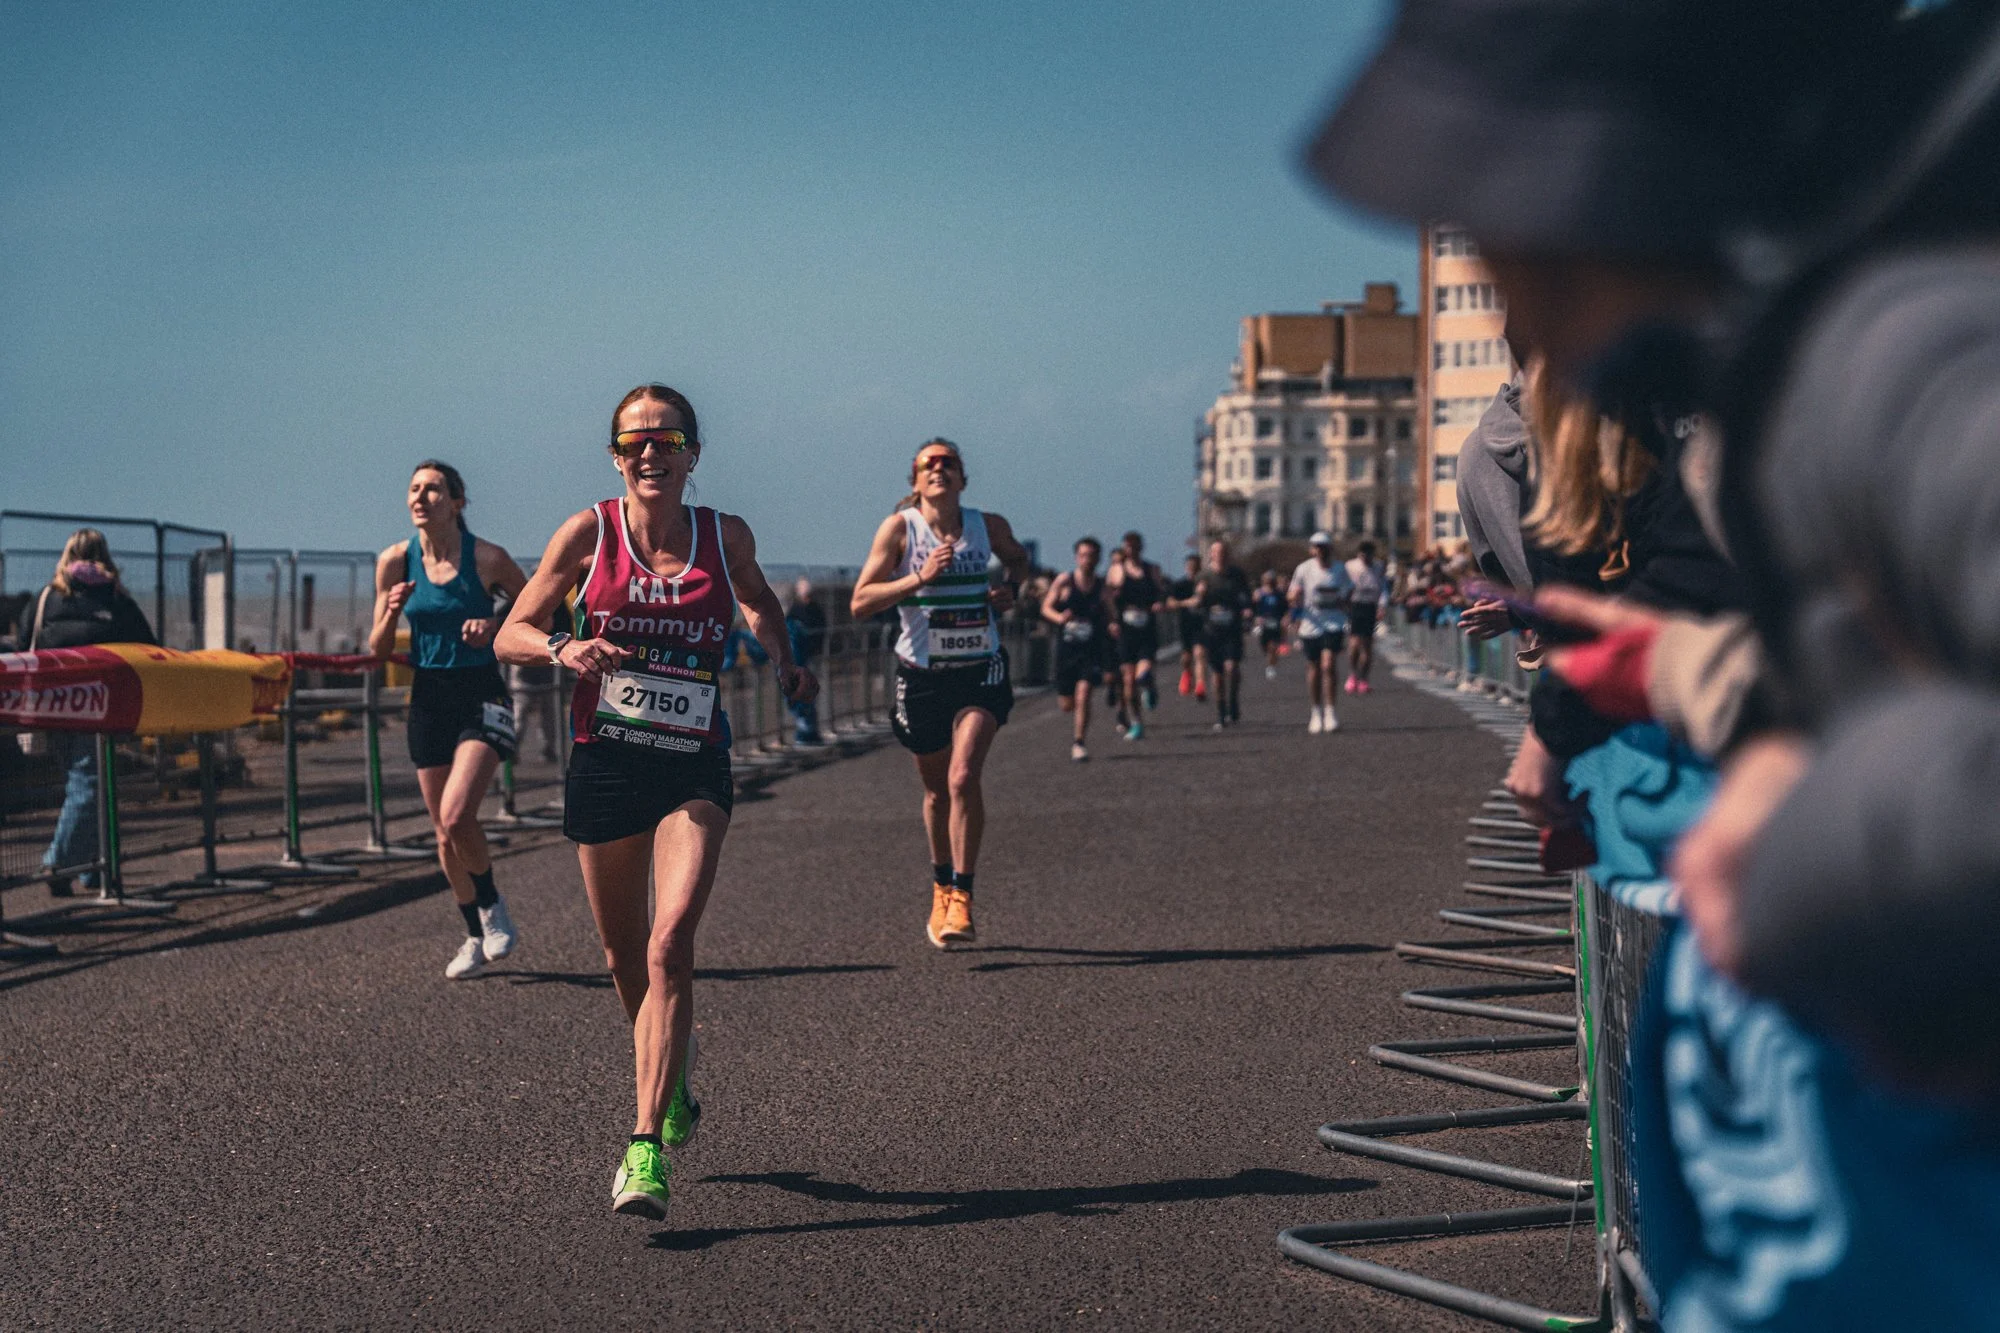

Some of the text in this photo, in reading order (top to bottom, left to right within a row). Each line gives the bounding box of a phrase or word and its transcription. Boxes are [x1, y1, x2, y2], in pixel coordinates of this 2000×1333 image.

[629, 575, 684, 605] KAT
[593, 611, 724, 643] Tommy's
[940, 636, 982, 649] 18053
[648, 663, 695, 677] MARATHON
[621, 686, 690, 715] 27150
[624, 735, 652, 746] EVENTS
[625, 729, 657, 740] LONDON
[657, 734, 701, 748] MARATHON
